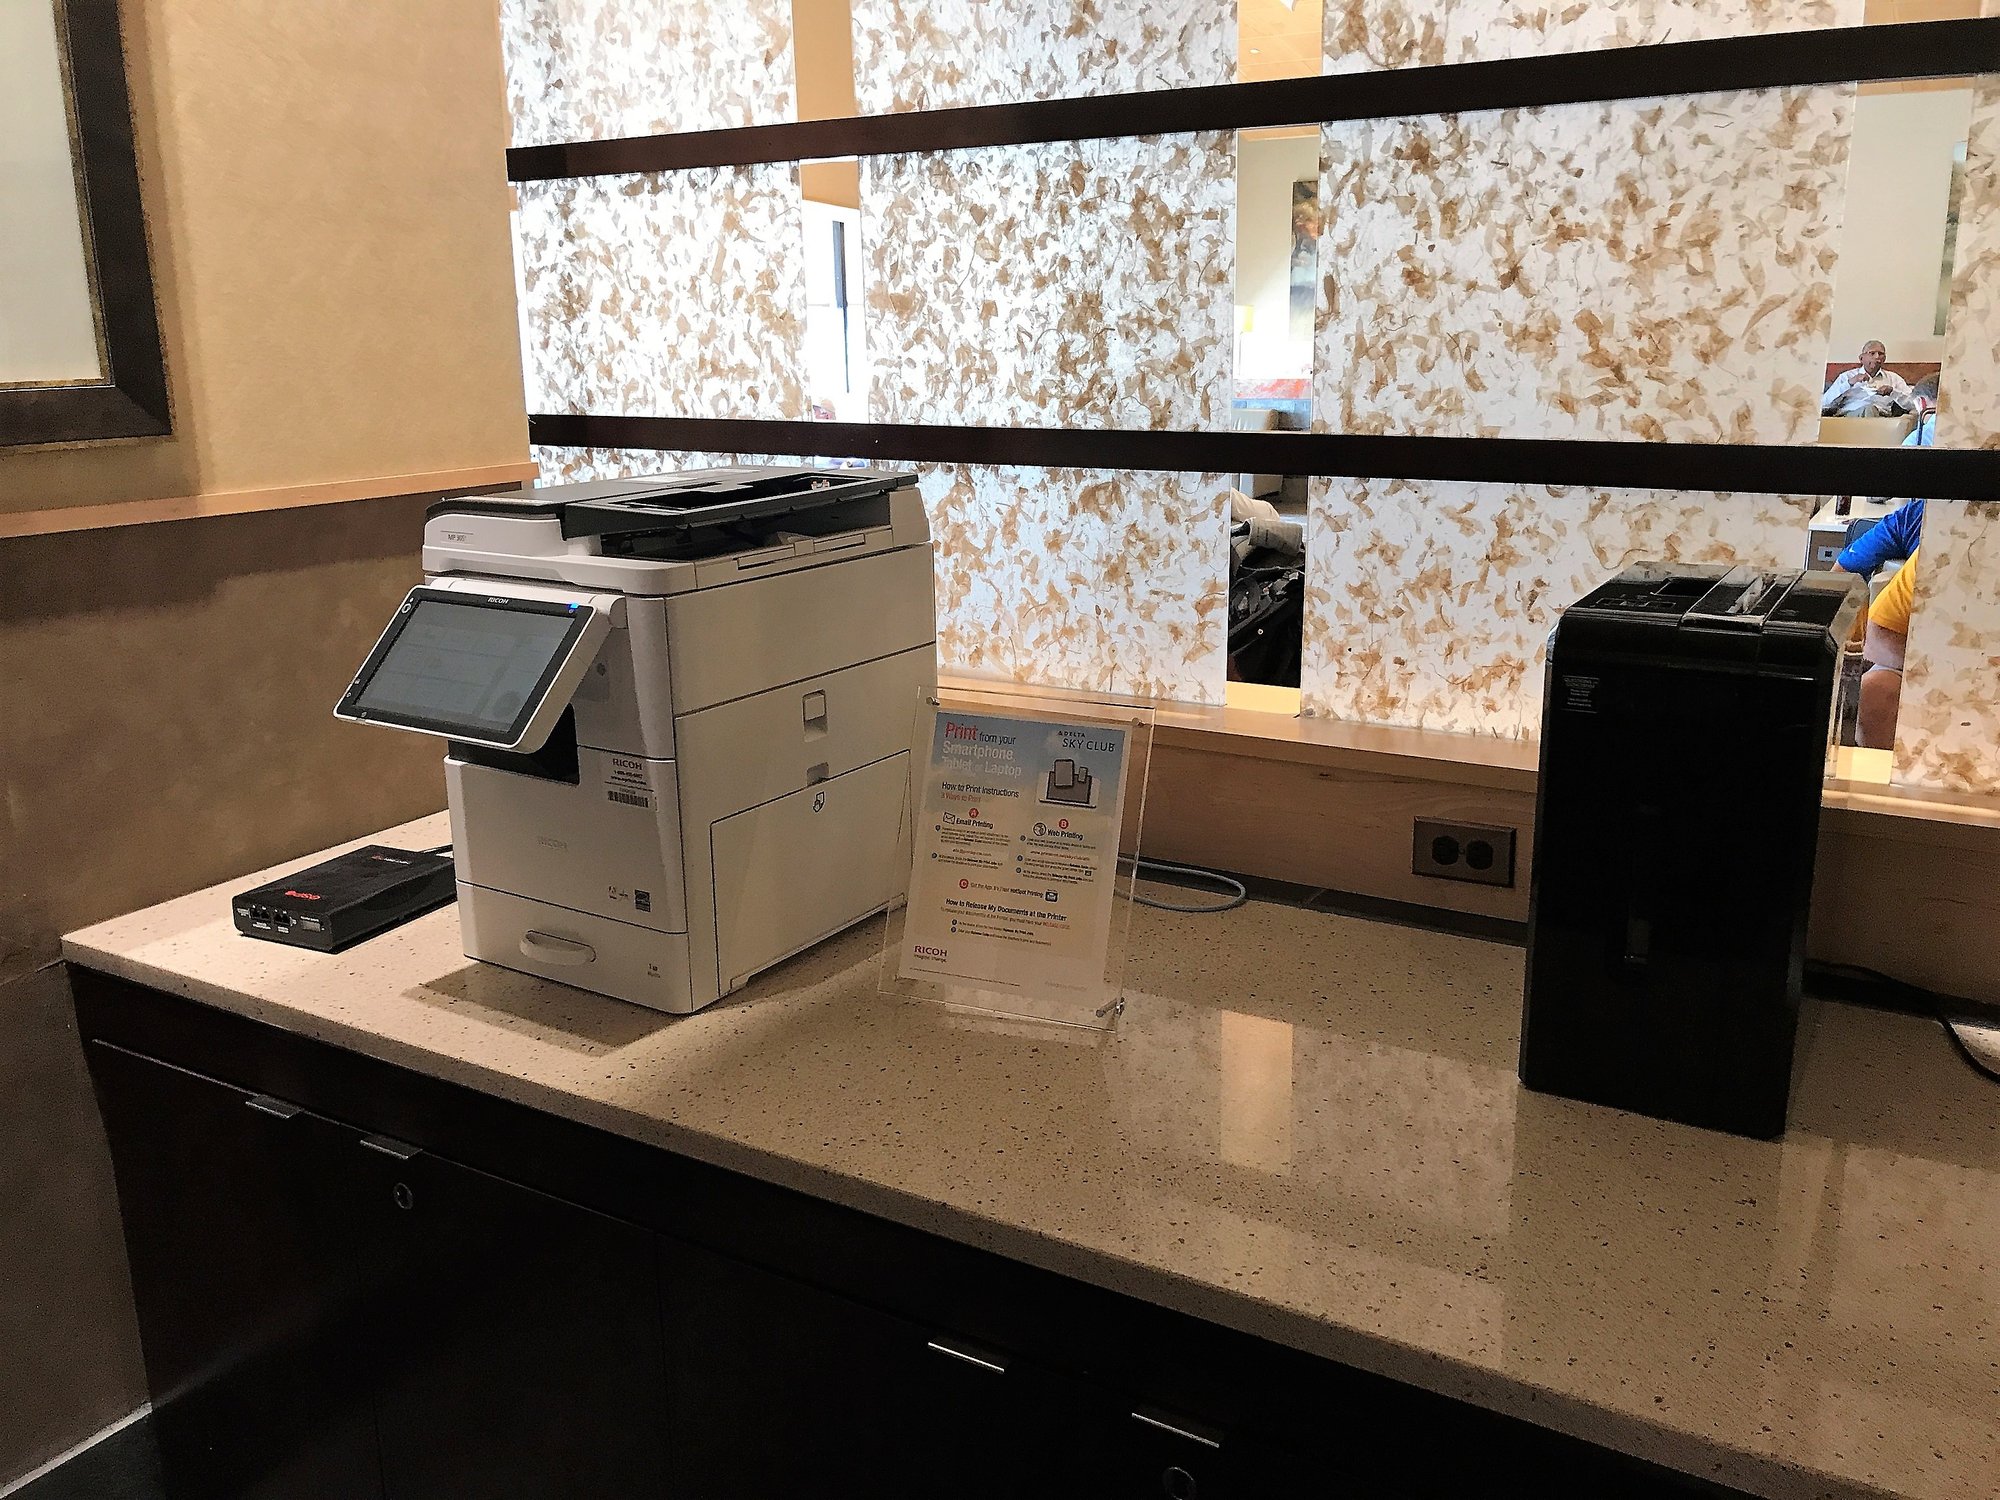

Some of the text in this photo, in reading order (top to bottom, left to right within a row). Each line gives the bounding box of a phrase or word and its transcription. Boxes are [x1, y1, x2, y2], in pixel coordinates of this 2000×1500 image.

[945, 721, 1016, 746] Print from your
[1062, 738, 1116, 752] SKY CLUB
[612, 758, 643, 770] RICOH
[941, 756, 974, 772] Tablet
[985, 760, 1022, 778] Laptop
[941, 781, 1019, 798] How to Print Instructions
[956, 818, 993, 830] Email Printing
[1047, 829, 1083, 841] Web Printing
[946, 899, 958, 907] How
[966, 901, 987, 910] Release
[988, 904, 997, 912] My
[998, 906, 1029, 916] Documents
[1047, 912, 1067, 921] Printer
[914, 945, 948, 957] RICOH
